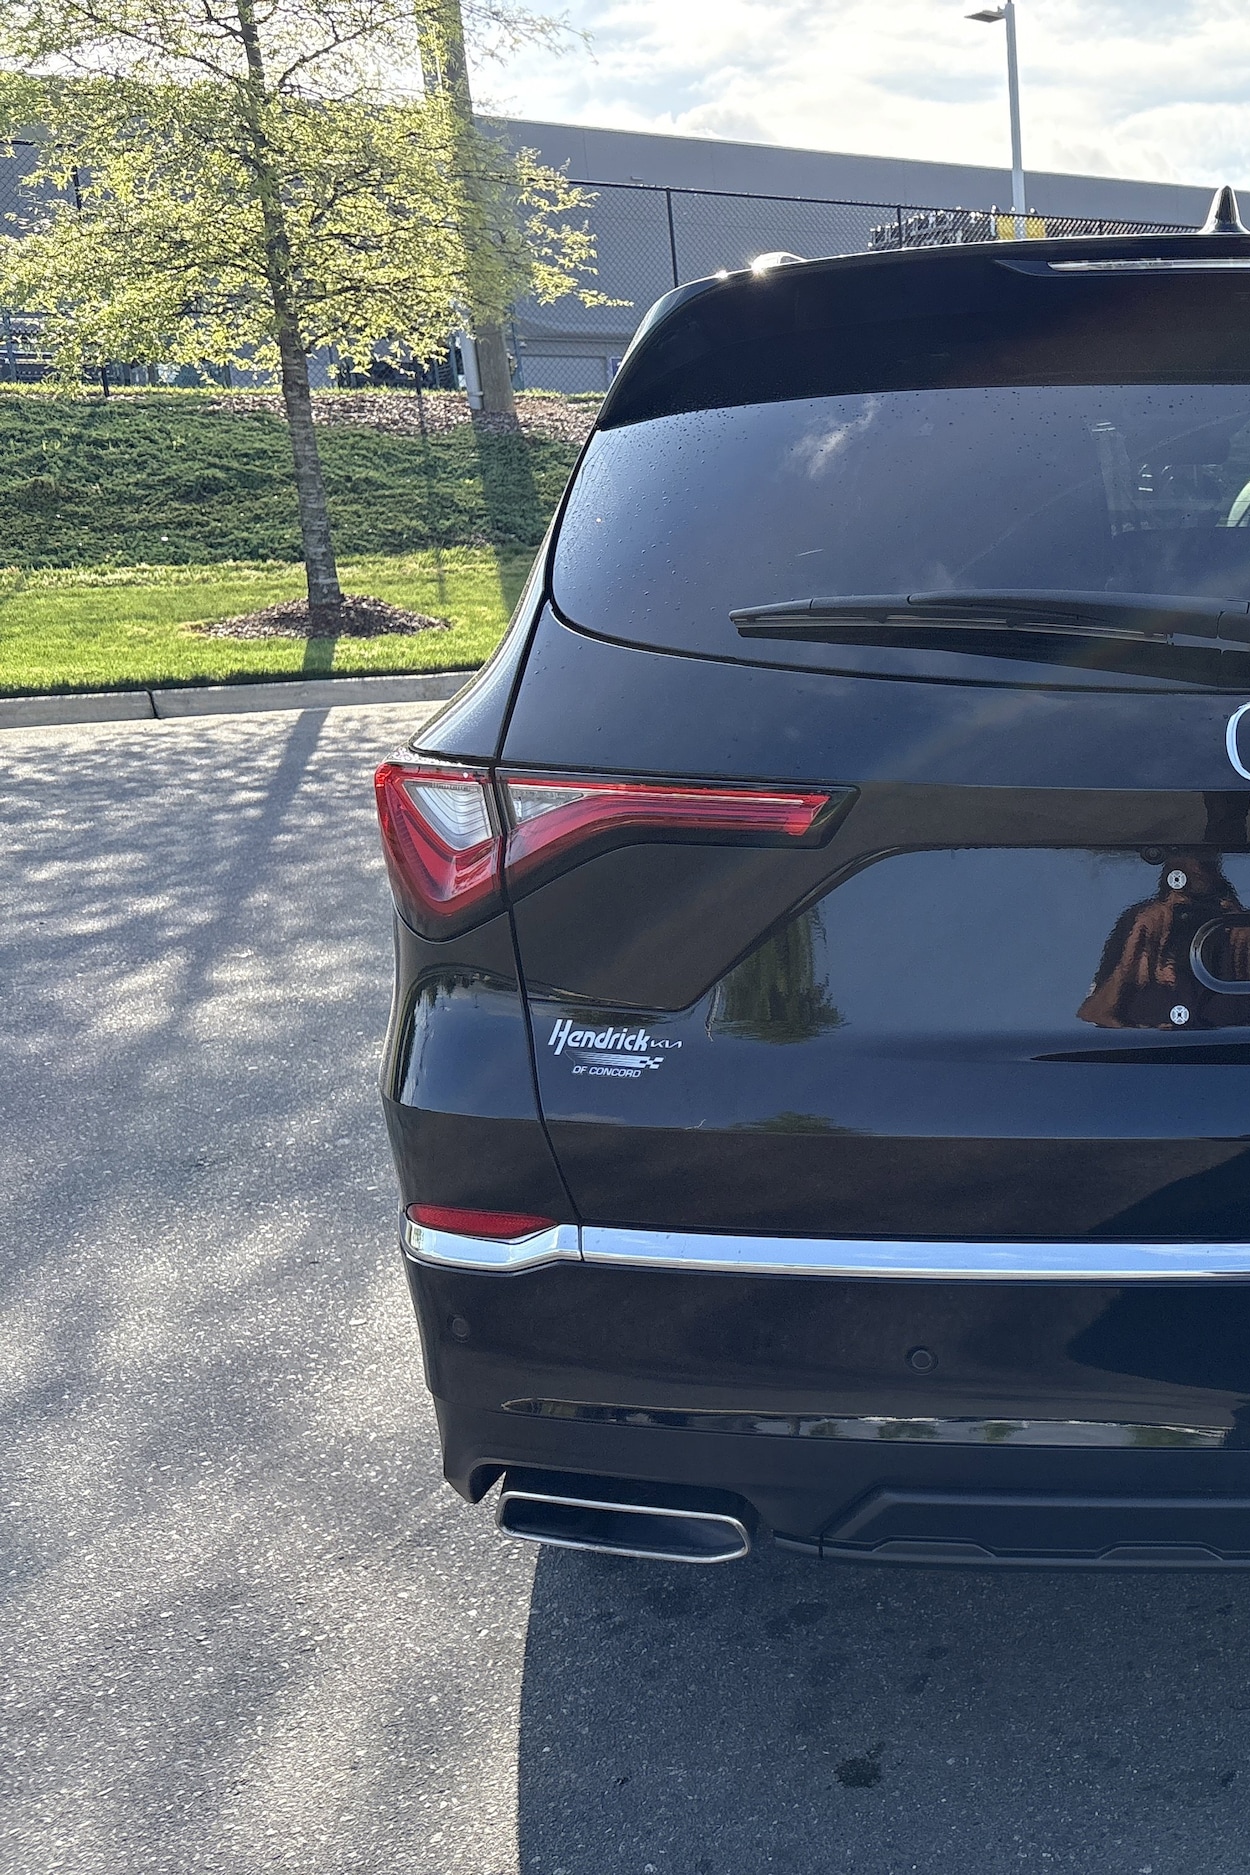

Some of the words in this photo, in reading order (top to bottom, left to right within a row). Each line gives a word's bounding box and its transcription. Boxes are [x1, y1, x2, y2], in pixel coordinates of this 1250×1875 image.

[548, 1019, 650, 1055] Hendrick
[572, 1065, 588, 1074] OF
[588, 1067, 641, 1078] CONCORD
